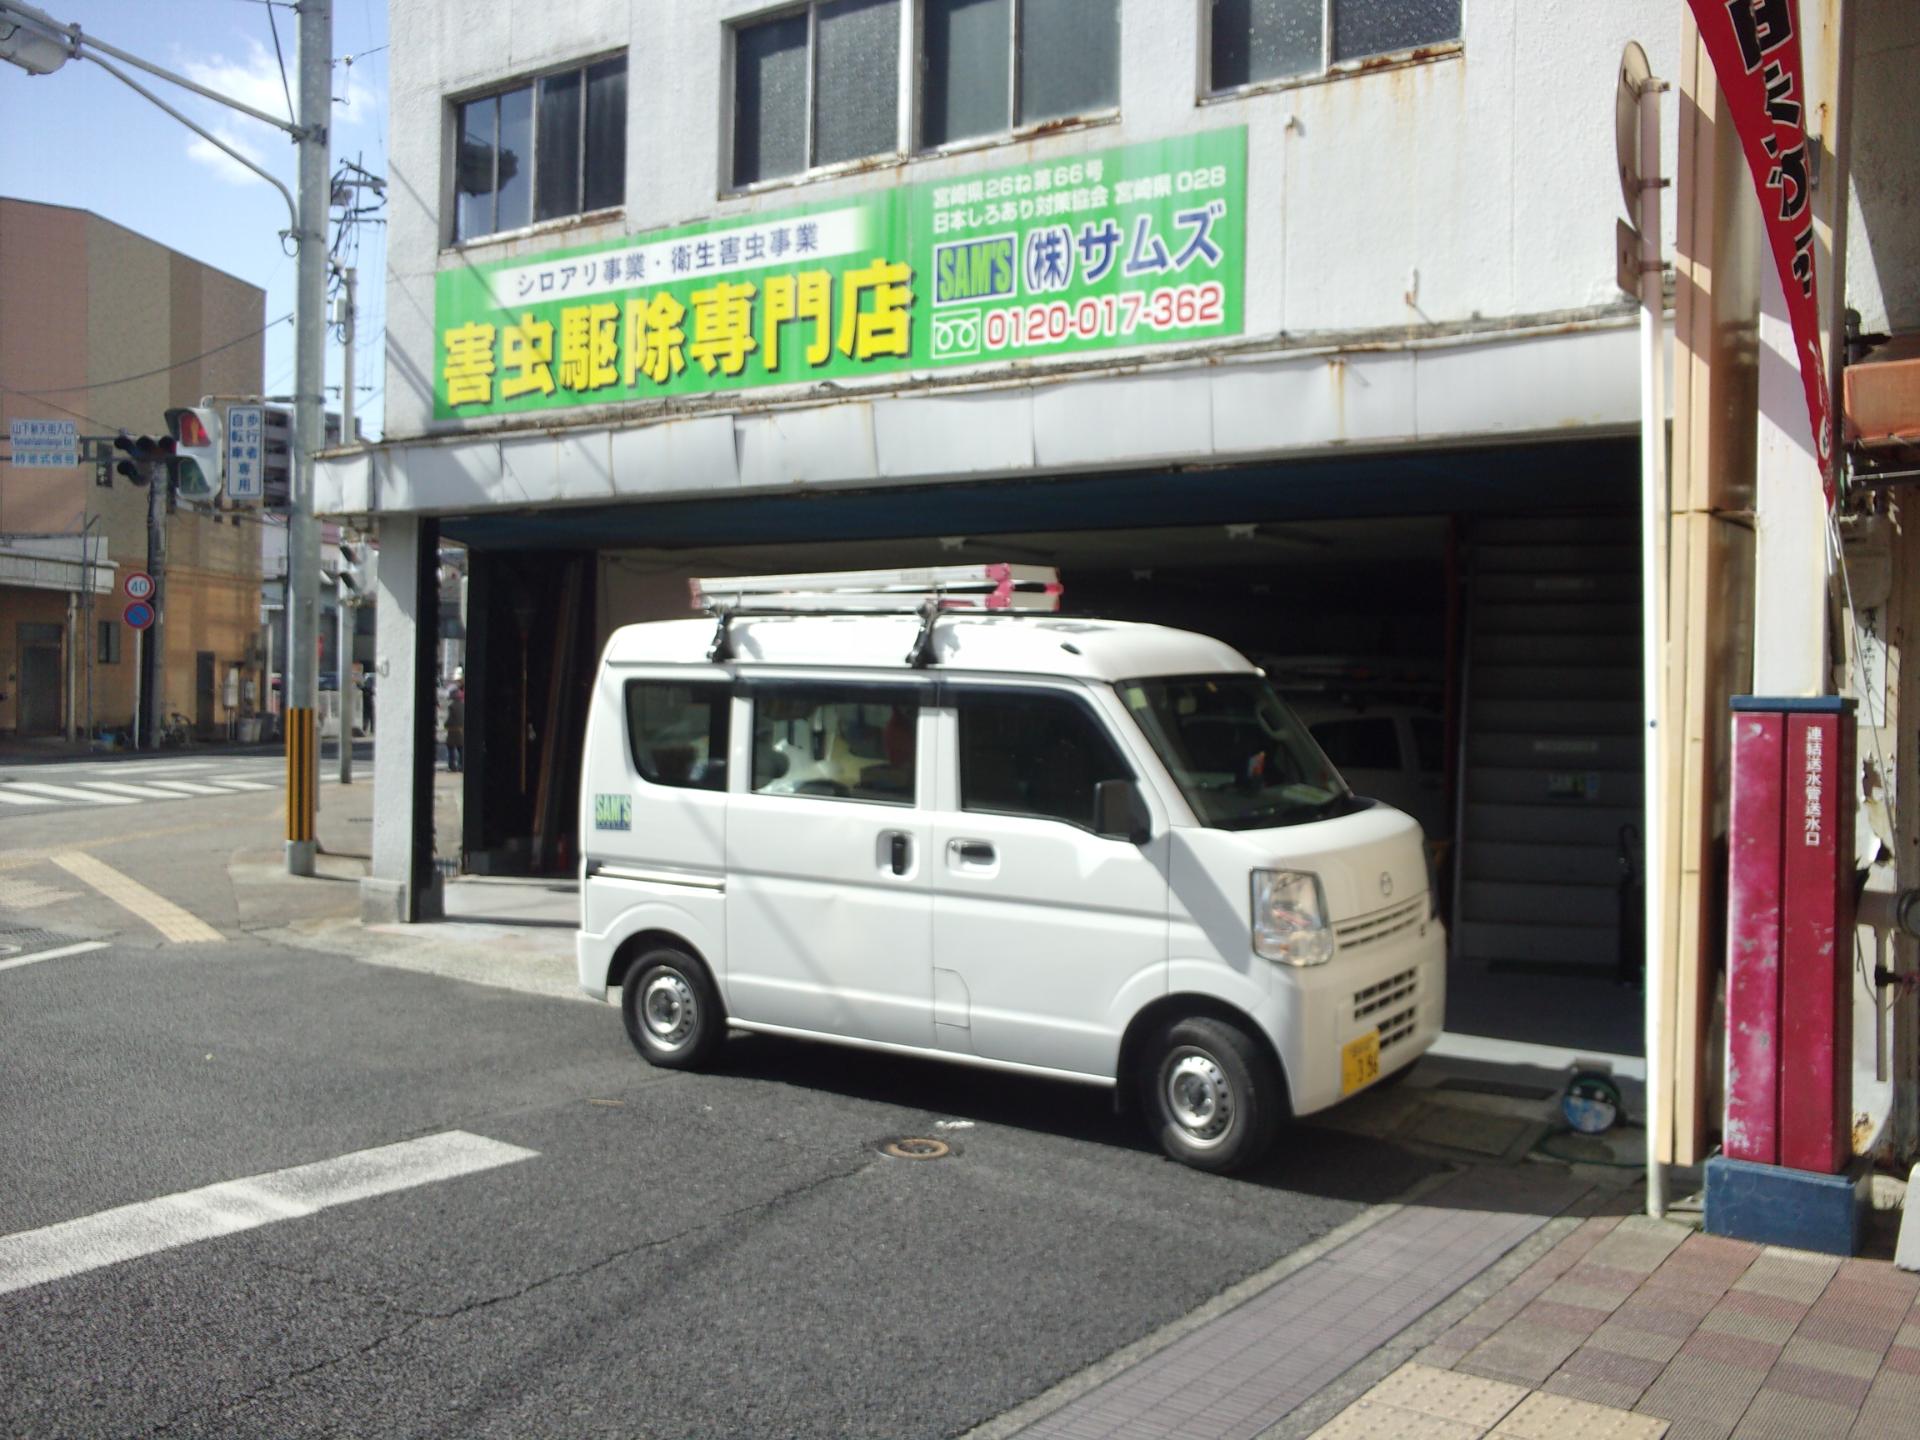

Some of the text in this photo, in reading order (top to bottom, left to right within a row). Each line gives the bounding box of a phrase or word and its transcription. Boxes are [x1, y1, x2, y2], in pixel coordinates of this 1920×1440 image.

[933, 186, 1109, 233] 日本しろあり対策協会
[517, 222, 819, 297] シロアリ事業・衛生害虫事業
[938, 241, 1014, 300] SAM'S
[443, 258, 913, 408] 害虫駆除専門店
[987, 286, 1221, 346] 0120-017-362
[15, 454, 75, 465] 時差式信号
[232, 414, 243, 458] 自転車
[239, 463, 251, 492] 専用
[131, 581, 147, 592] 40
[1805, 726, 1822, 847] 連結送水管送水口
[596, 794, 632, 830] SAM'S
